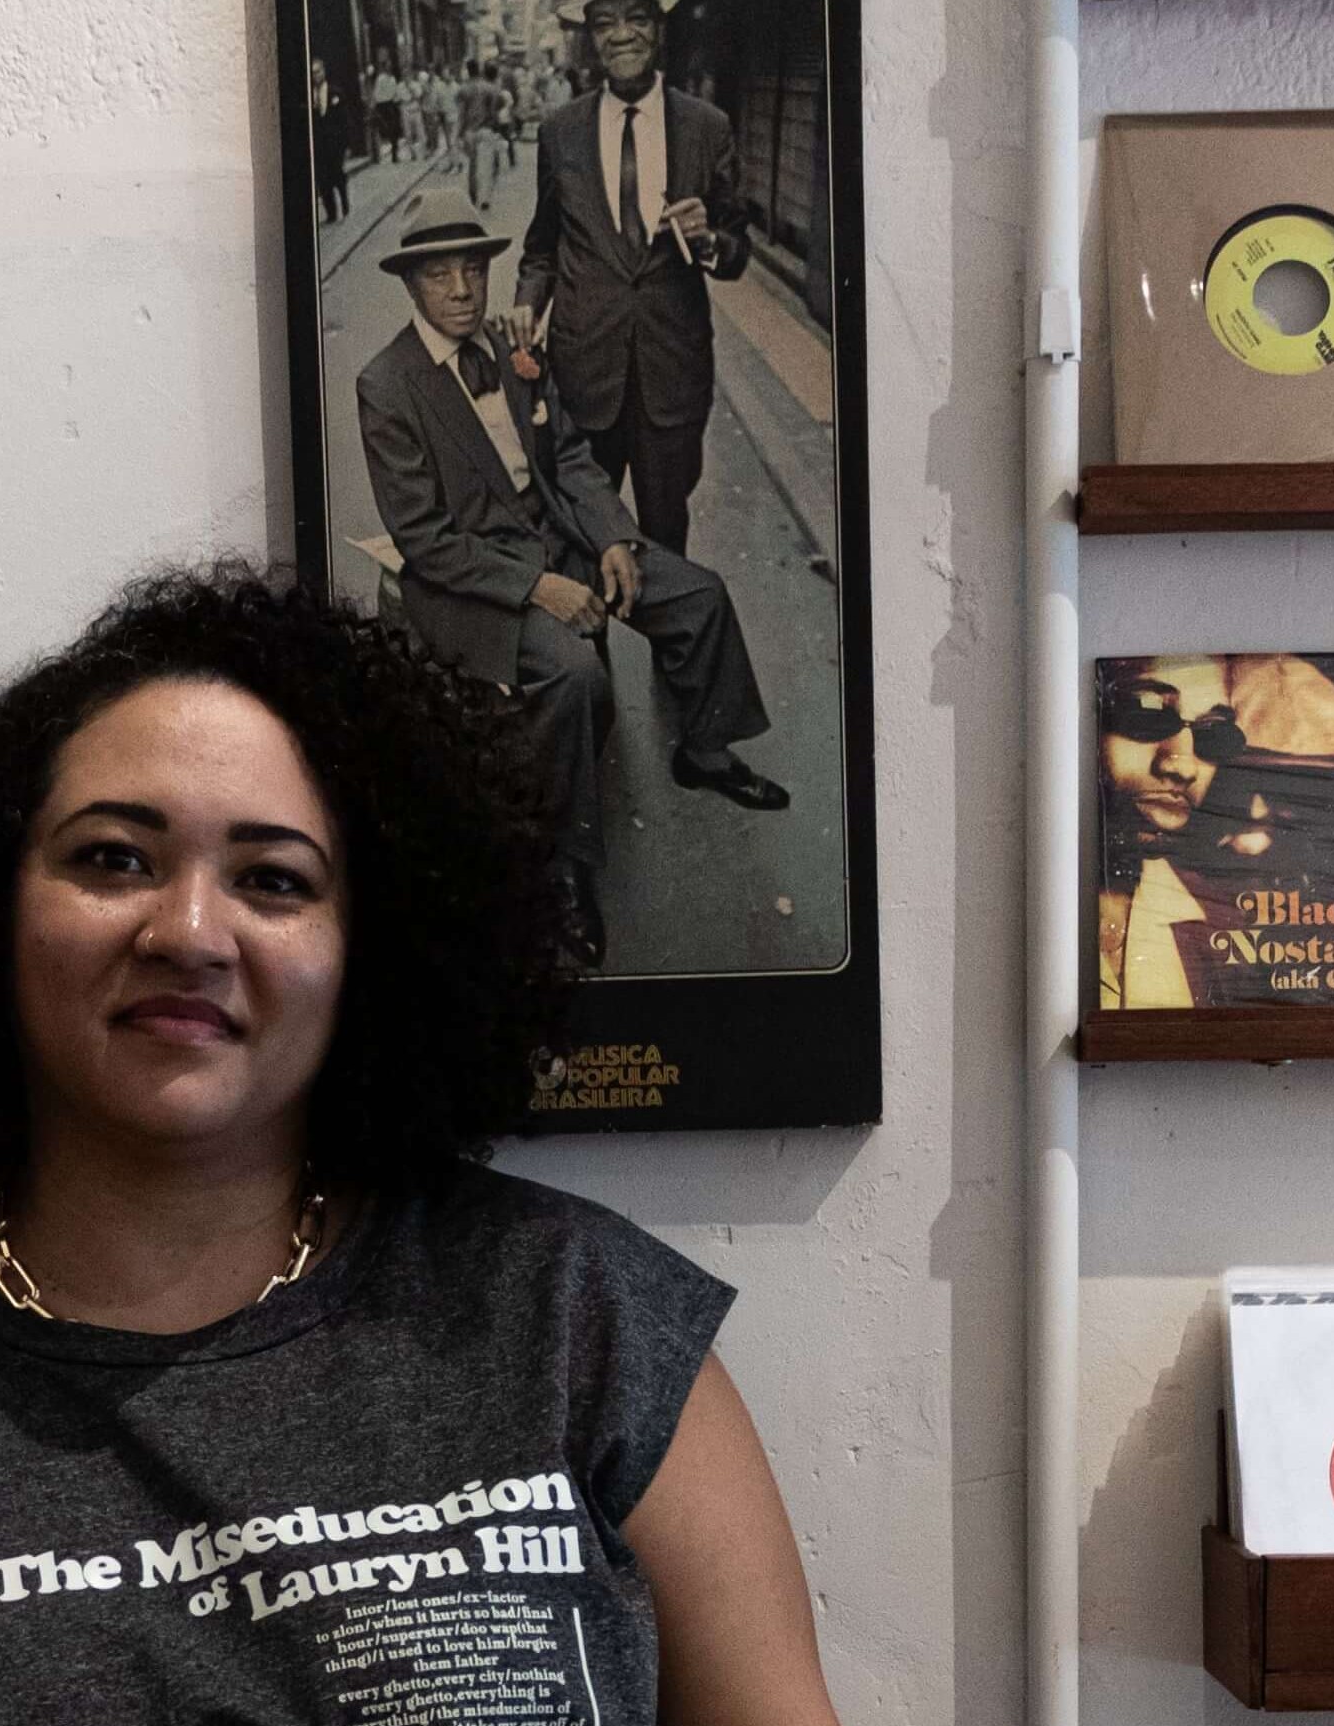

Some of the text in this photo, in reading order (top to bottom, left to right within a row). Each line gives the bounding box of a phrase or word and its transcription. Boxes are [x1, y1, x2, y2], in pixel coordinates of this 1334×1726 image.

[568, 1064, 681, 1088] POPULAR
[529, 1087, 664, 1112] BRASILEIRA
[133, 1472, 577, 1589] Miseducation
[188, 1525, 586, 1622] of Lauryn Hill
[316, 1632, 330, 1645] to
[416, 1610, 428, 1625] it
[431, 1608, 471, 1623] hurts
[474, 1608, 490, 1620] so
[387, 1644, 424, 1661] used
[426, 1641, 441, 1654] to
[443, 1639, 474, 1652] love
[413, 1653, 500, 1673] them father
[338, 1685, 380, 1704] every
[361, 1698, 403, 1717] every
[538, 1684, 551, 1698] is
[463, 1701, 554, 1718] miseducation
[556, 1700, 572, 1715] of
